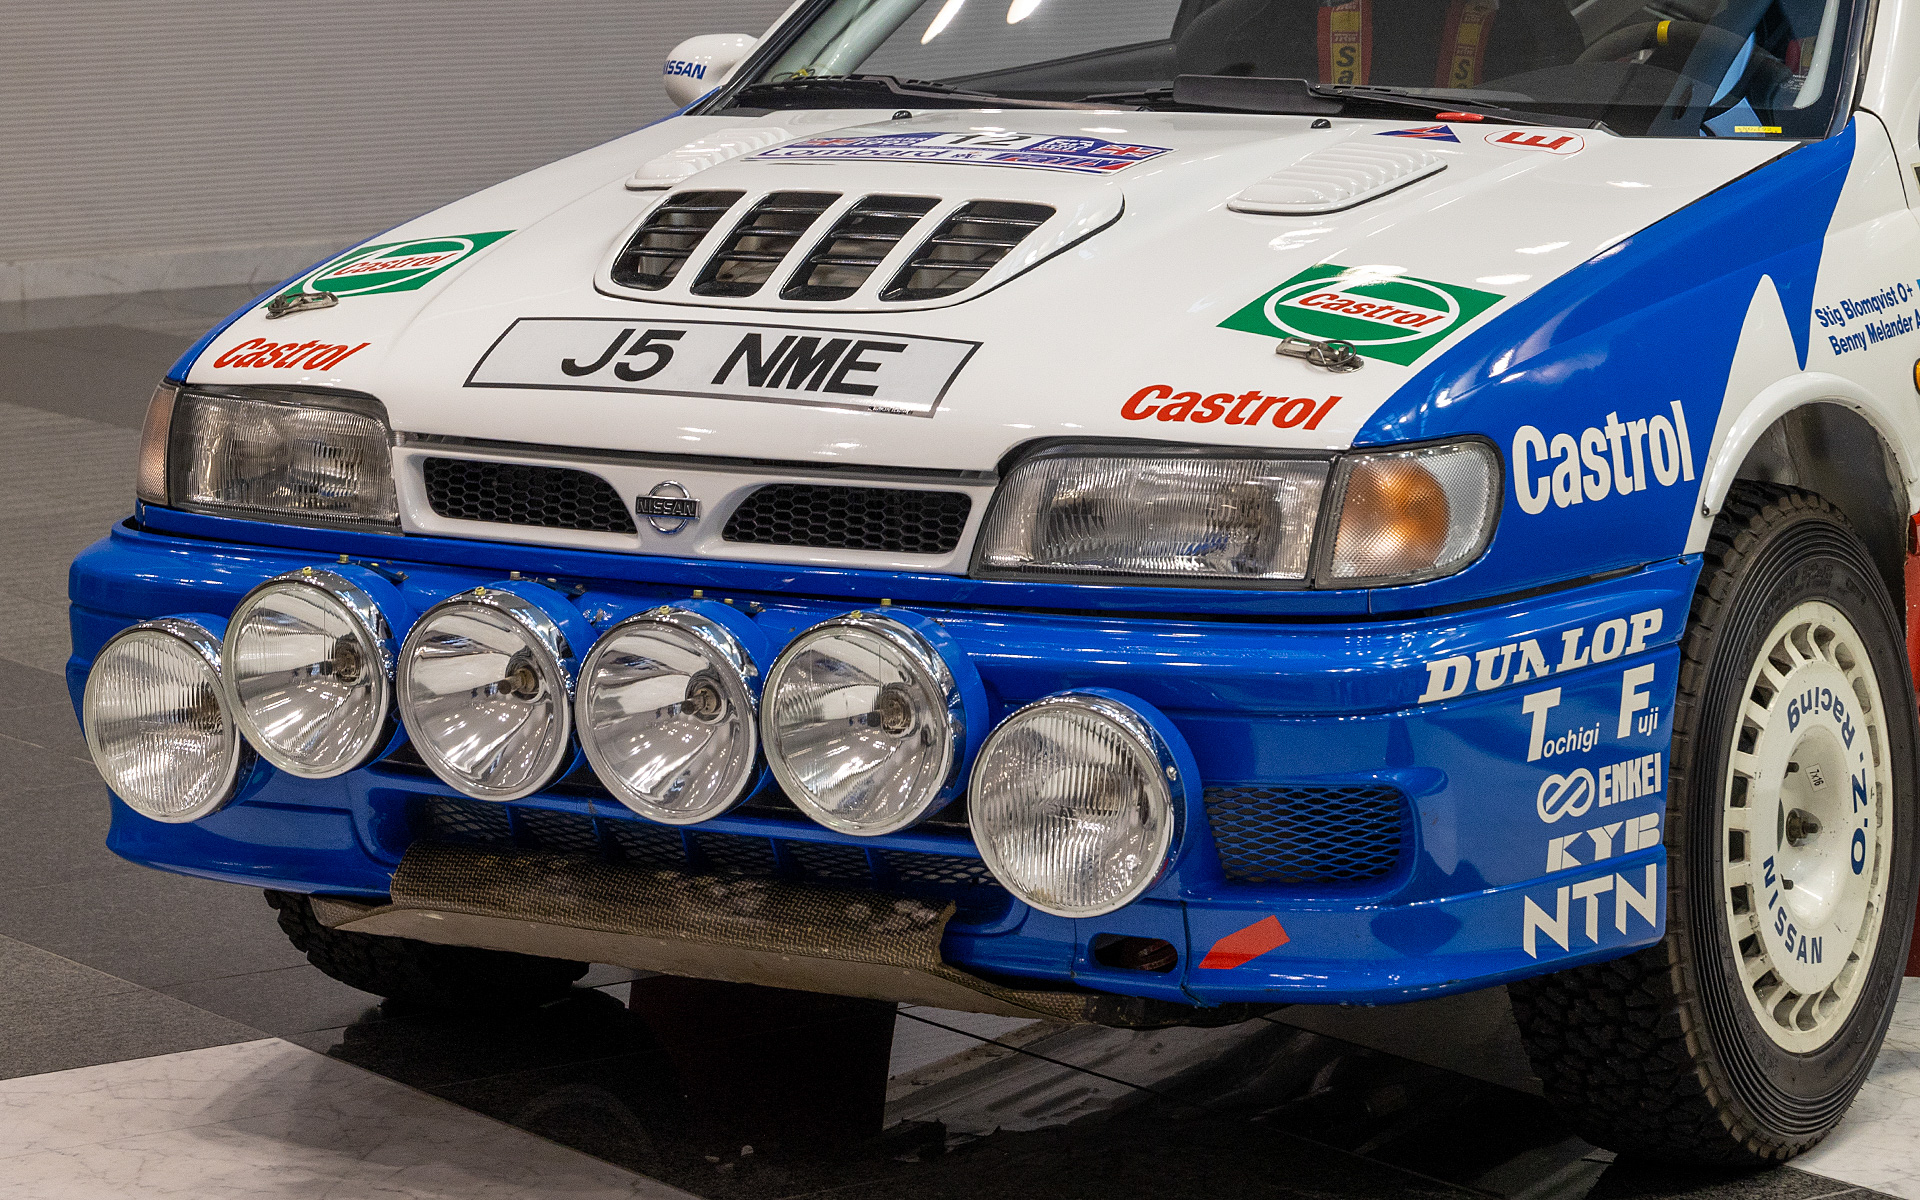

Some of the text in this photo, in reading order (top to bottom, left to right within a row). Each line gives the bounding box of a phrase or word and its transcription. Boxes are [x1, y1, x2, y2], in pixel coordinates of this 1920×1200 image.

[757, 148, 948, 157] Lombard
[1494, 131, 1575, 150] E
[333, 252, 458, 276] Castrol
[1298, 292, 1445, 329] Castrol
[1814, 283, 1913, 328] Stig Blomqvist O+
[212, 337, 371, 371] Castrol
[1828, 331, 1867, 356] Benny
[1865, 314, 1913, 344] Melander
[561, 328, 909, 397] J5 NME
[1120, 384, 1343, 430] Castrol
[1512, 400, 1695, 515] Castrol
[637, 498, 695, 516] NISSAN
[1417, 608, 1664, 704] DUNLOP
[1522, 663, 1659, 763] Tochigi Fuji
[1787, 687, 1855, 750] Racing
[1599, 752, 1661, 807] ENKEI
[1809, 769, 1824, 787] 7x16
[1546, 812, 1661, 873] KYB
[1523, 863, 1657, 959] NTN
[1763, 855, 1822, 964] NISSAN
